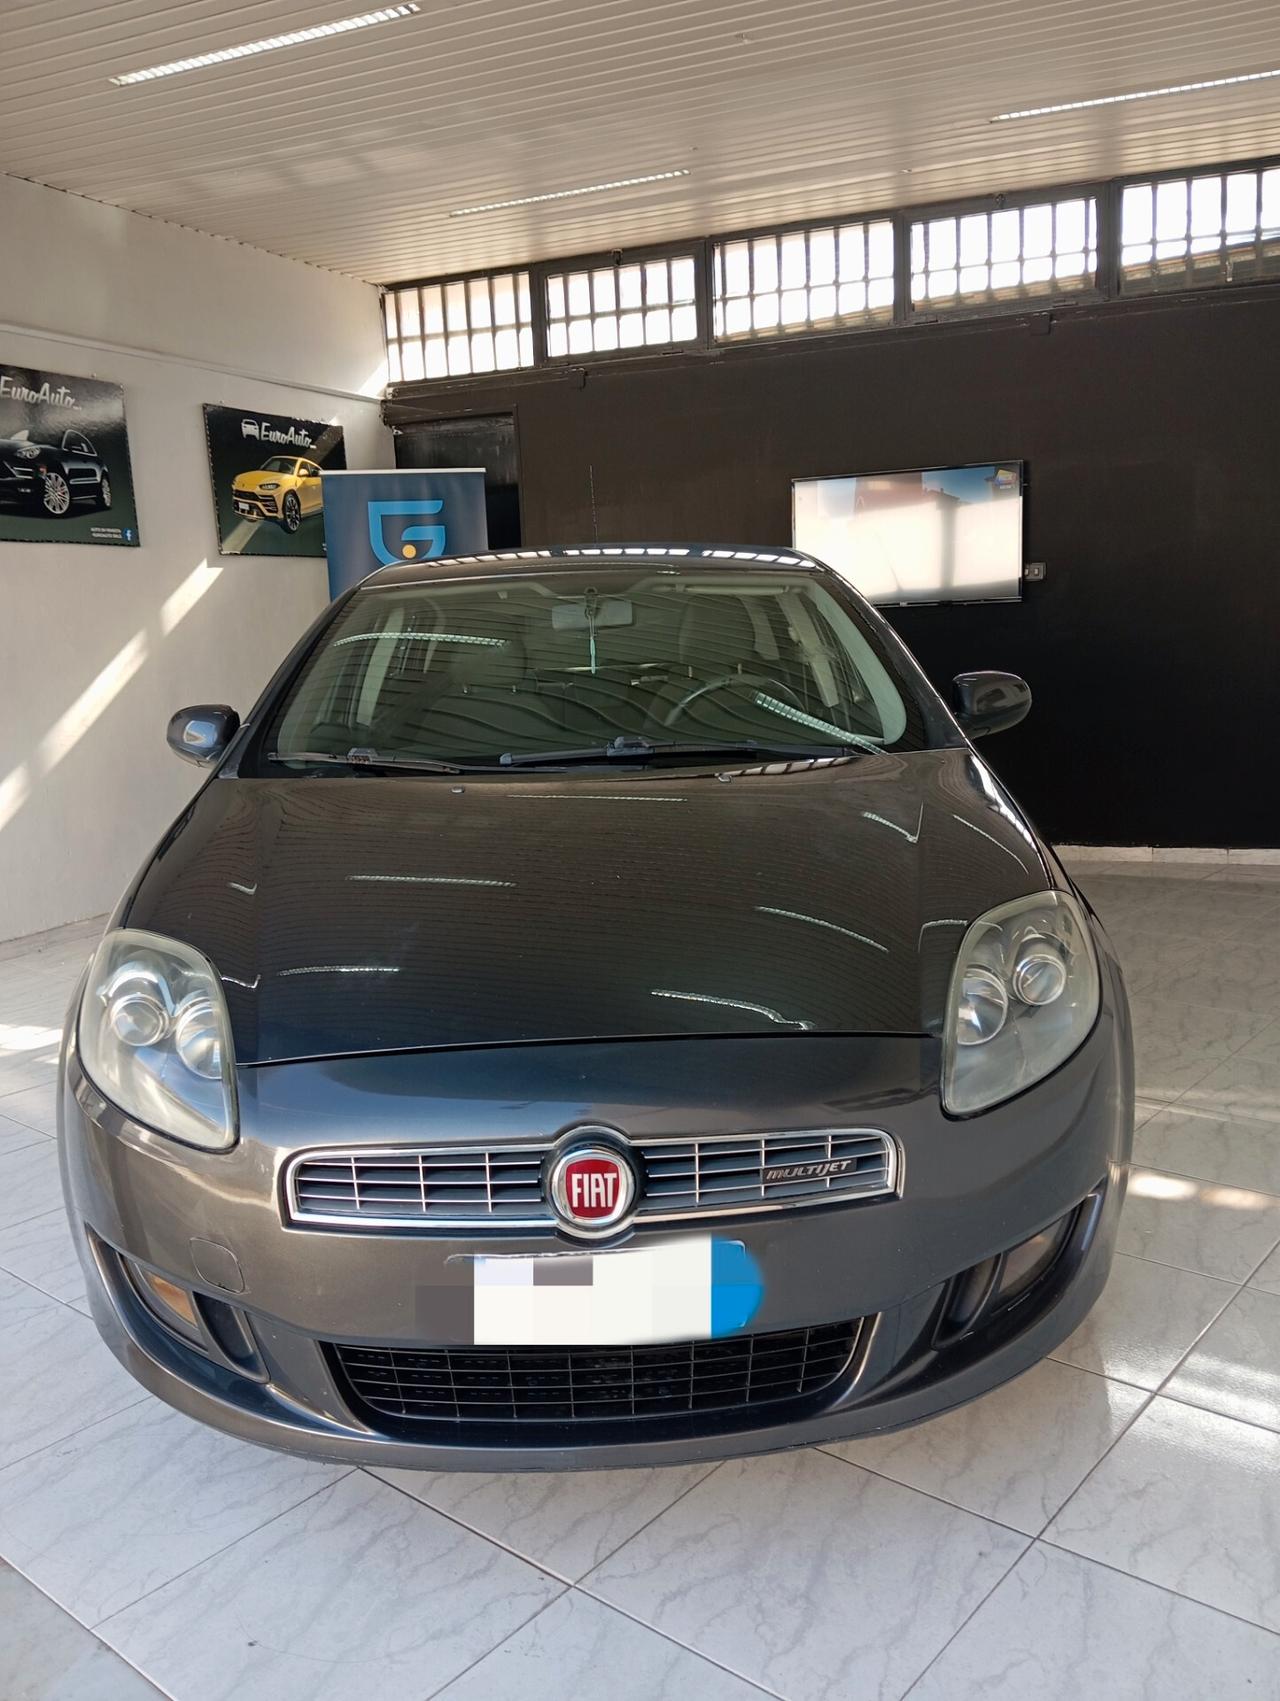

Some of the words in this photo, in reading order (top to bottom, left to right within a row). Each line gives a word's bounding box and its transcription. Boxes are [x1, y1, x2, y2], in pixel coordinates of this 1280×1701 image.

[0, 376, 76, 409] EuroAuto
[261, 422, 312, 448] EuroAuto
[766, 1160, 852, 1180] MULTIJET
[571, 1173, 617, 1208] FIAT
